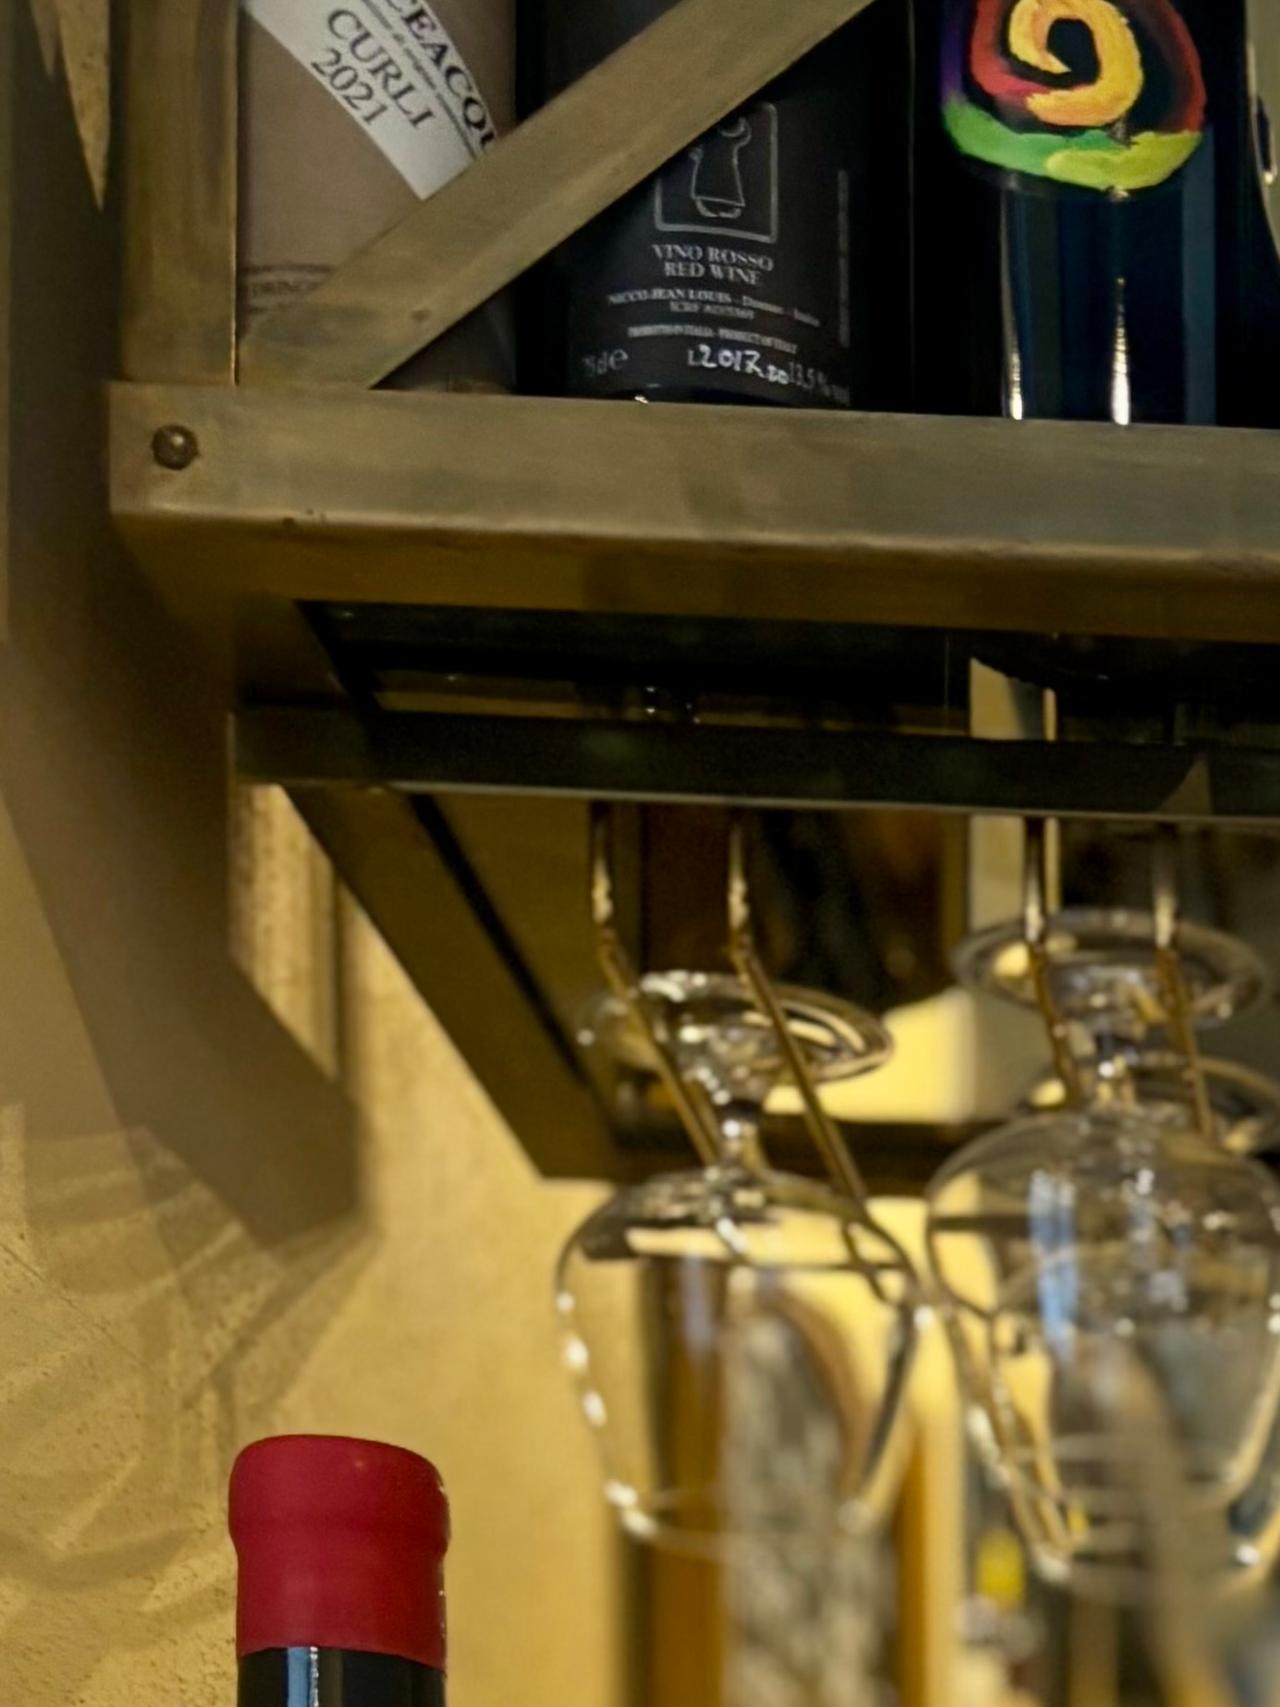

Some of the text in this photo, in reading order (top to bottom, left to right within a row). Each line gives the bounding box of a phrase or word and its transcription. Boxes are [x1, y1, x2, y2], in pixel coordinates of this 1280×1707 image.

[310, 47, 389, 125] 2021
[327, 8, 435, 129] CURLI
[652, 243, 774, 272] VINO ROSSO
[664, 261, 763, 286] RED WINE
